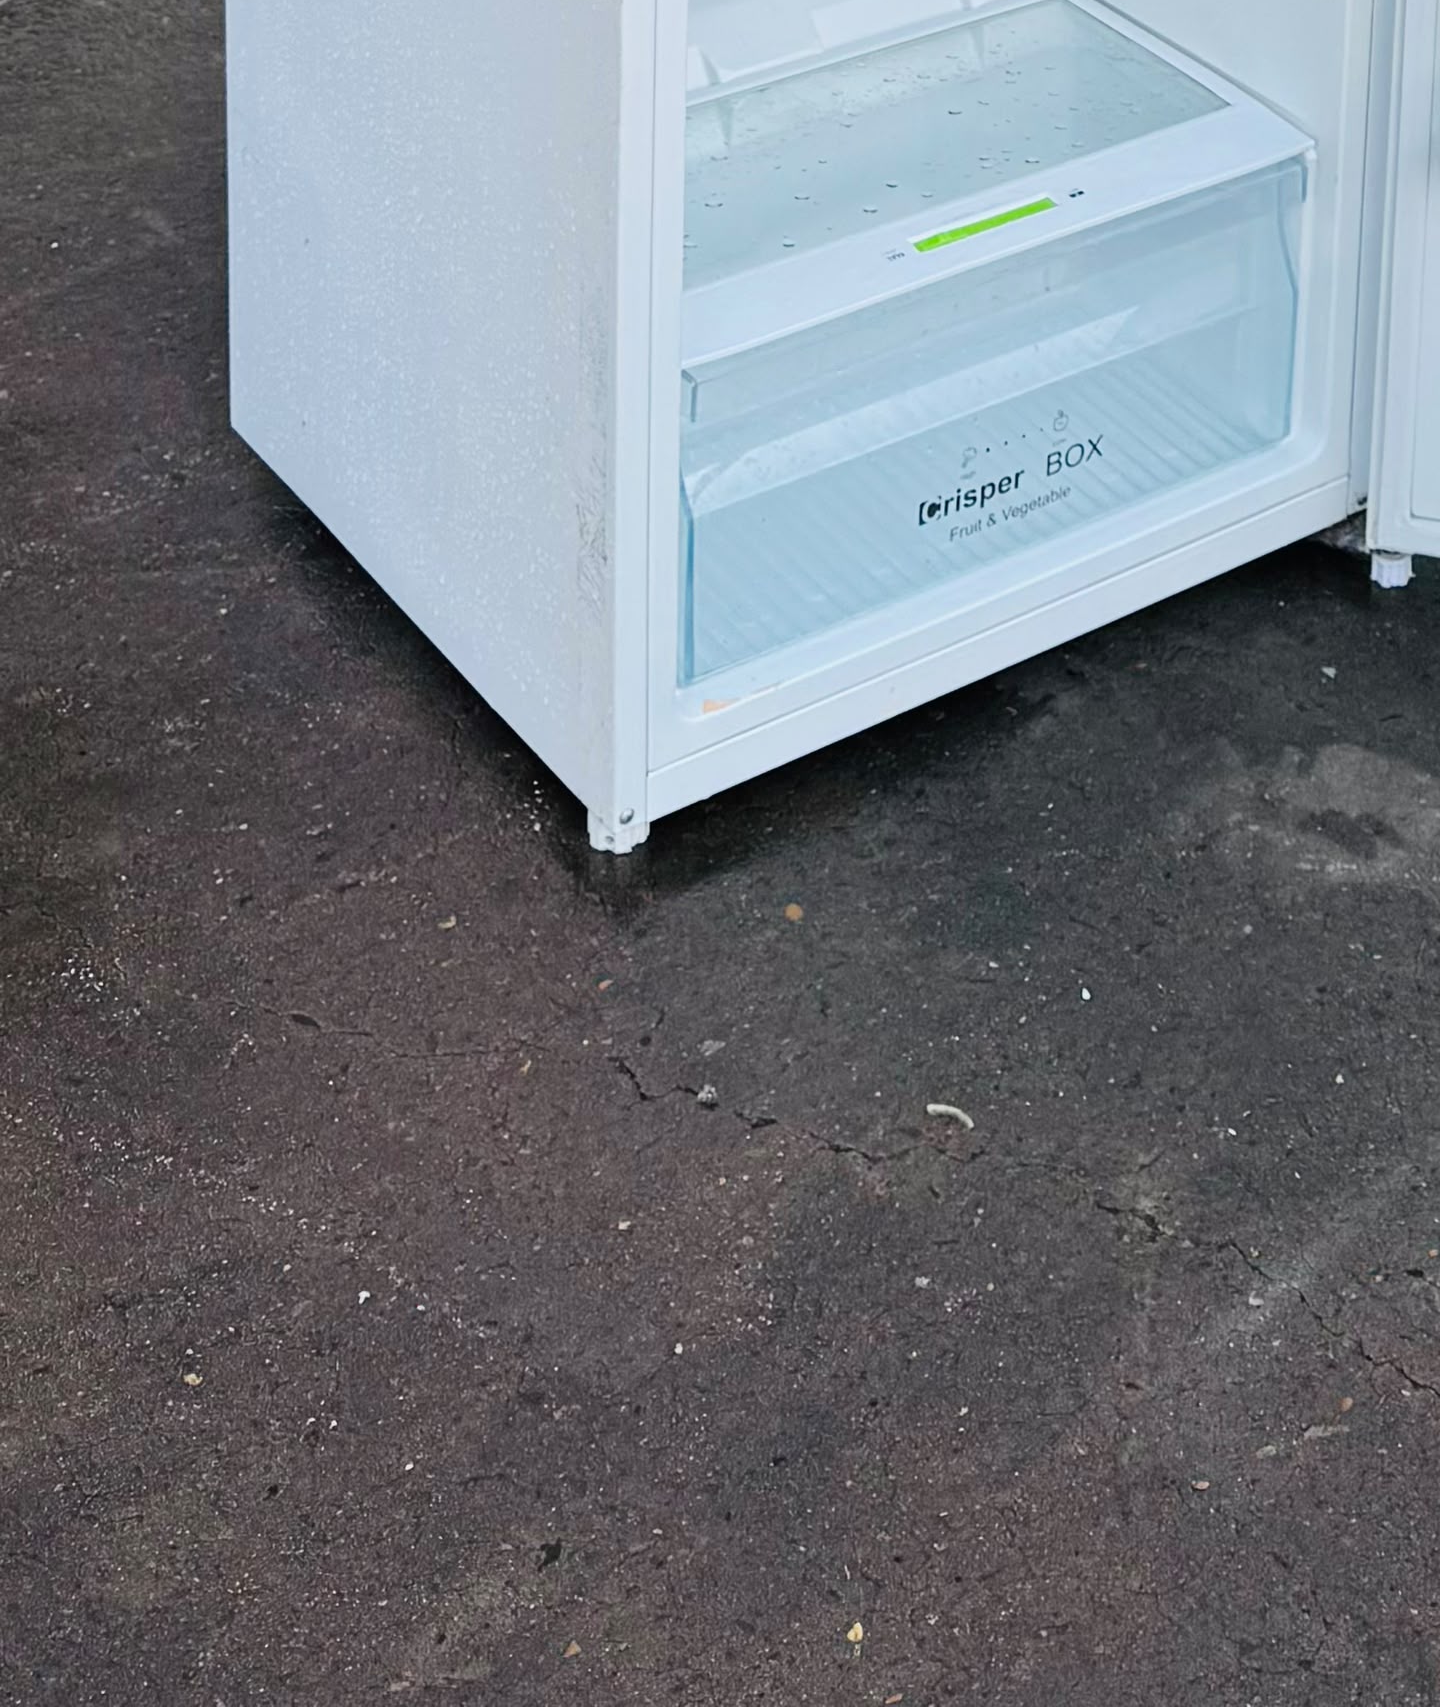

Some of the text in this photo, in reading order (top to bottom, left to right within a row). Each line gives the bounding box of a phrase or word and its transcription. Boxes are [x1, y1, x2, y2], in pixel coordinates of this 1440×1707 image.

[918, 434, 1104, 526] Crisper BOX
[949, 485, 1072, 542] Fruit & Vegetable
